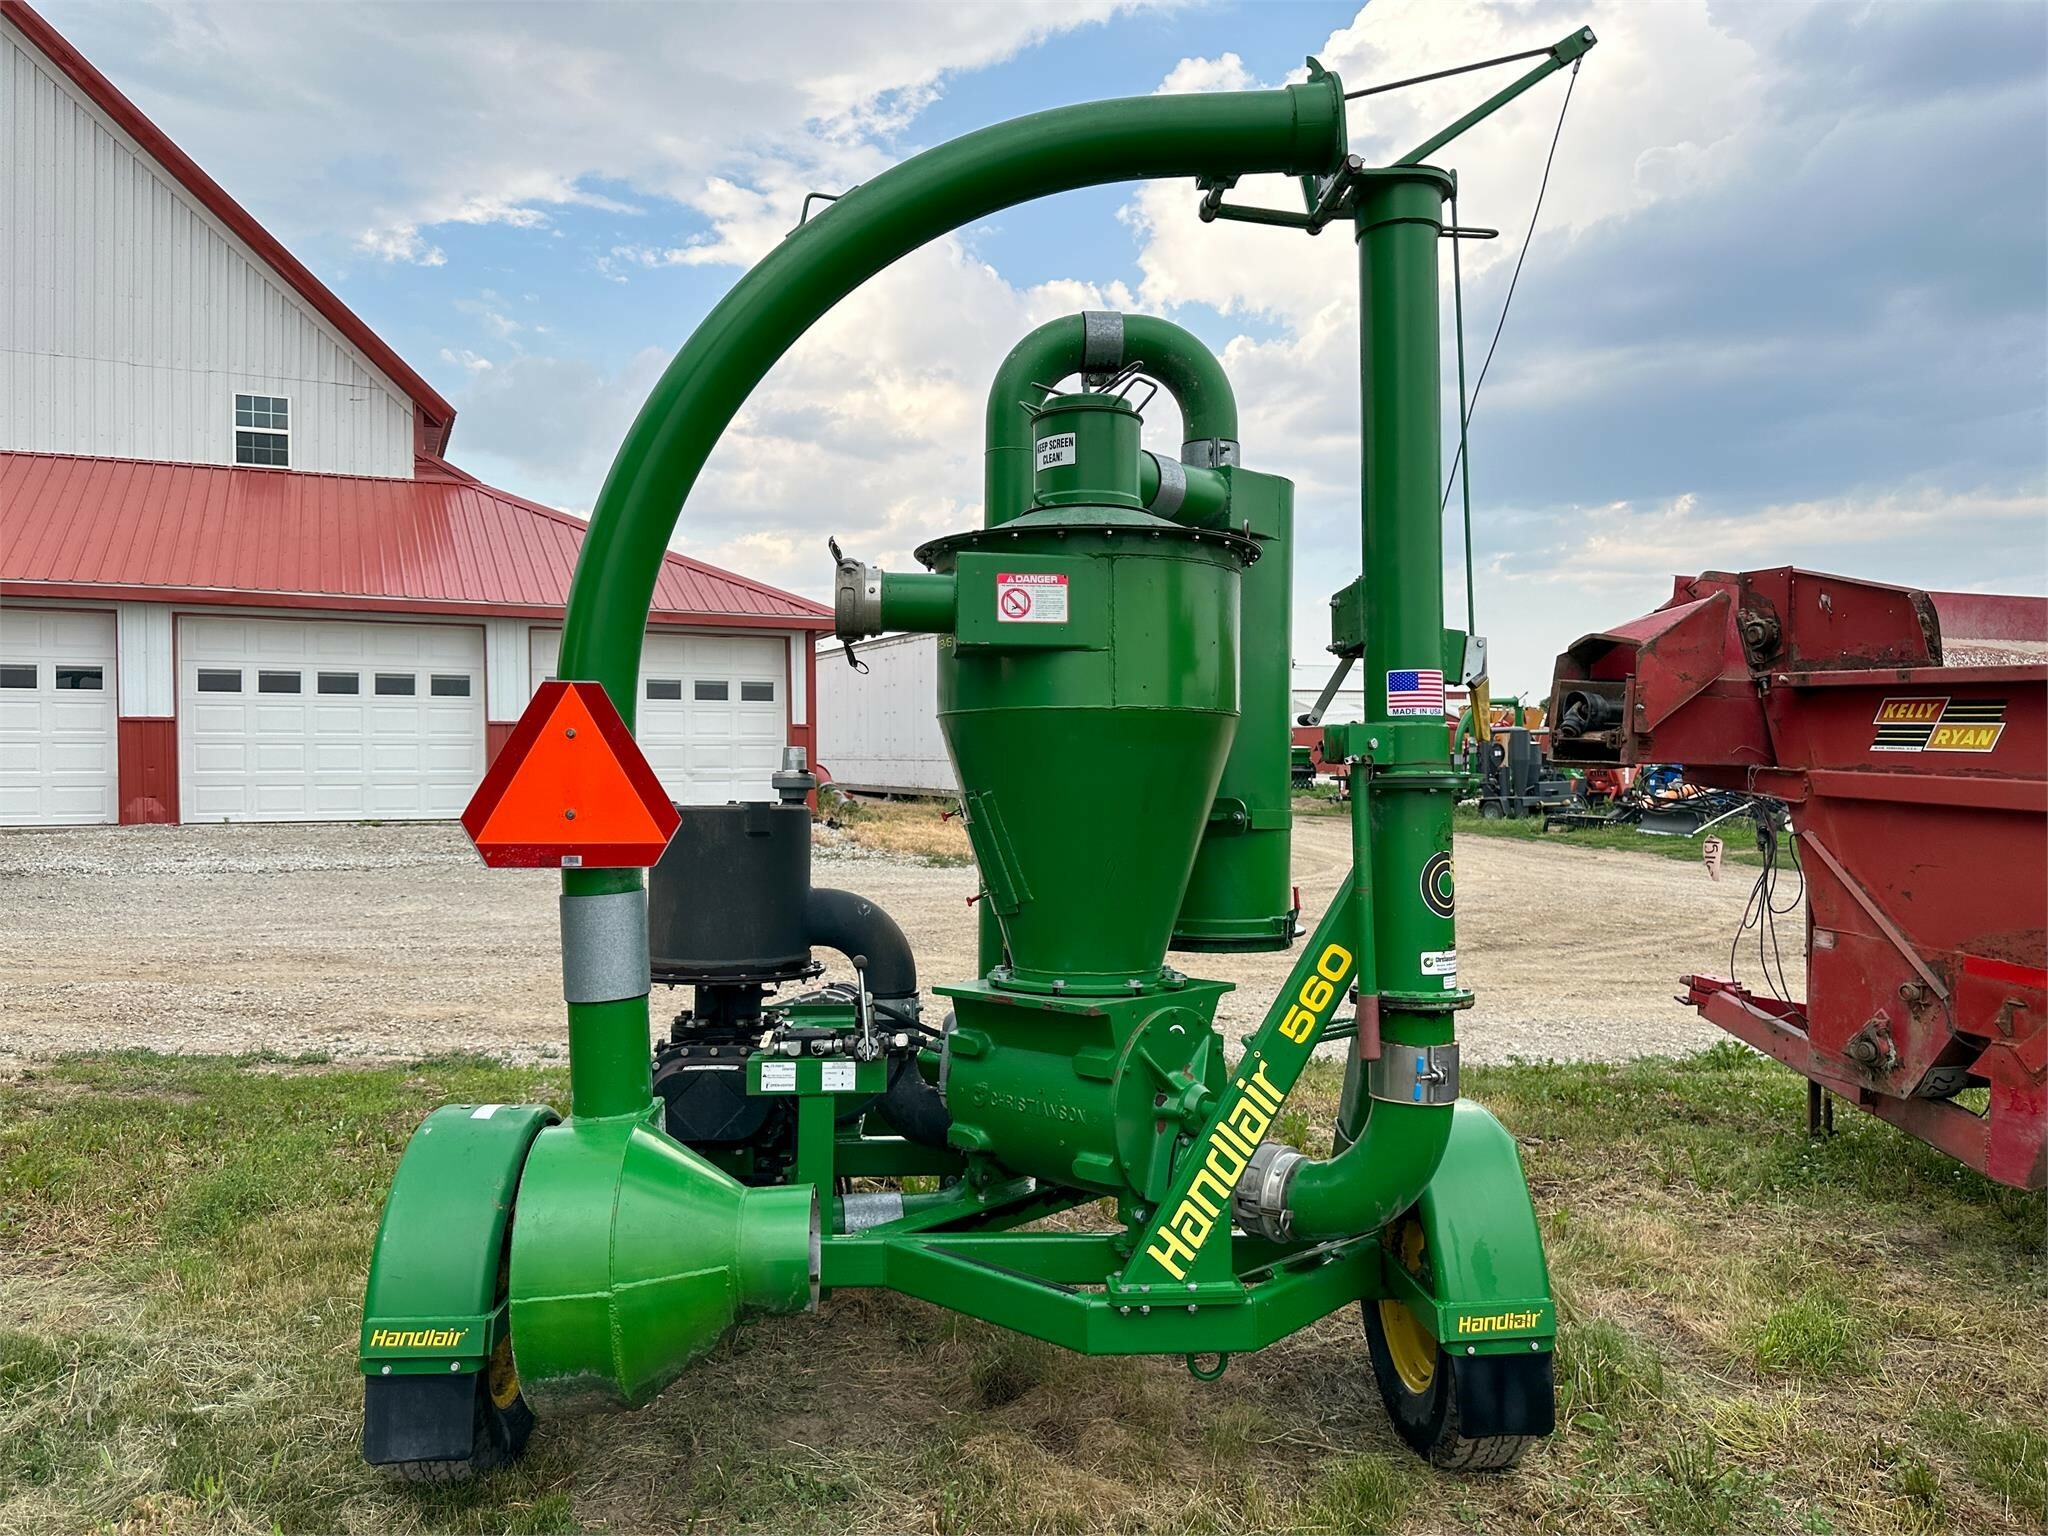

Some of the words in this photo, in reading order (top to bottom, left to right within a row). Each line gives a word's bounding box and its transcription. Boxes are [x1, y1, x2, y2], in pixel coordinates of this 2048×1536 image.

[1049, 437, 1074, 450] SCREEN
[1042, 451, 1063, 465] CLEAN!
[1015, 575, 1058, 584] DANGER
[1883, 703, 1939, 719] KELLY
[1933, 728, 1994, 746] RYAN
[1278, 943, 1353, 1045] 560
[1146, 1057, 1285, 1282] Handlair
[1458, 1309, 1542, 1334] Handlair
[370, 1327, 467, 1347] Handlair
